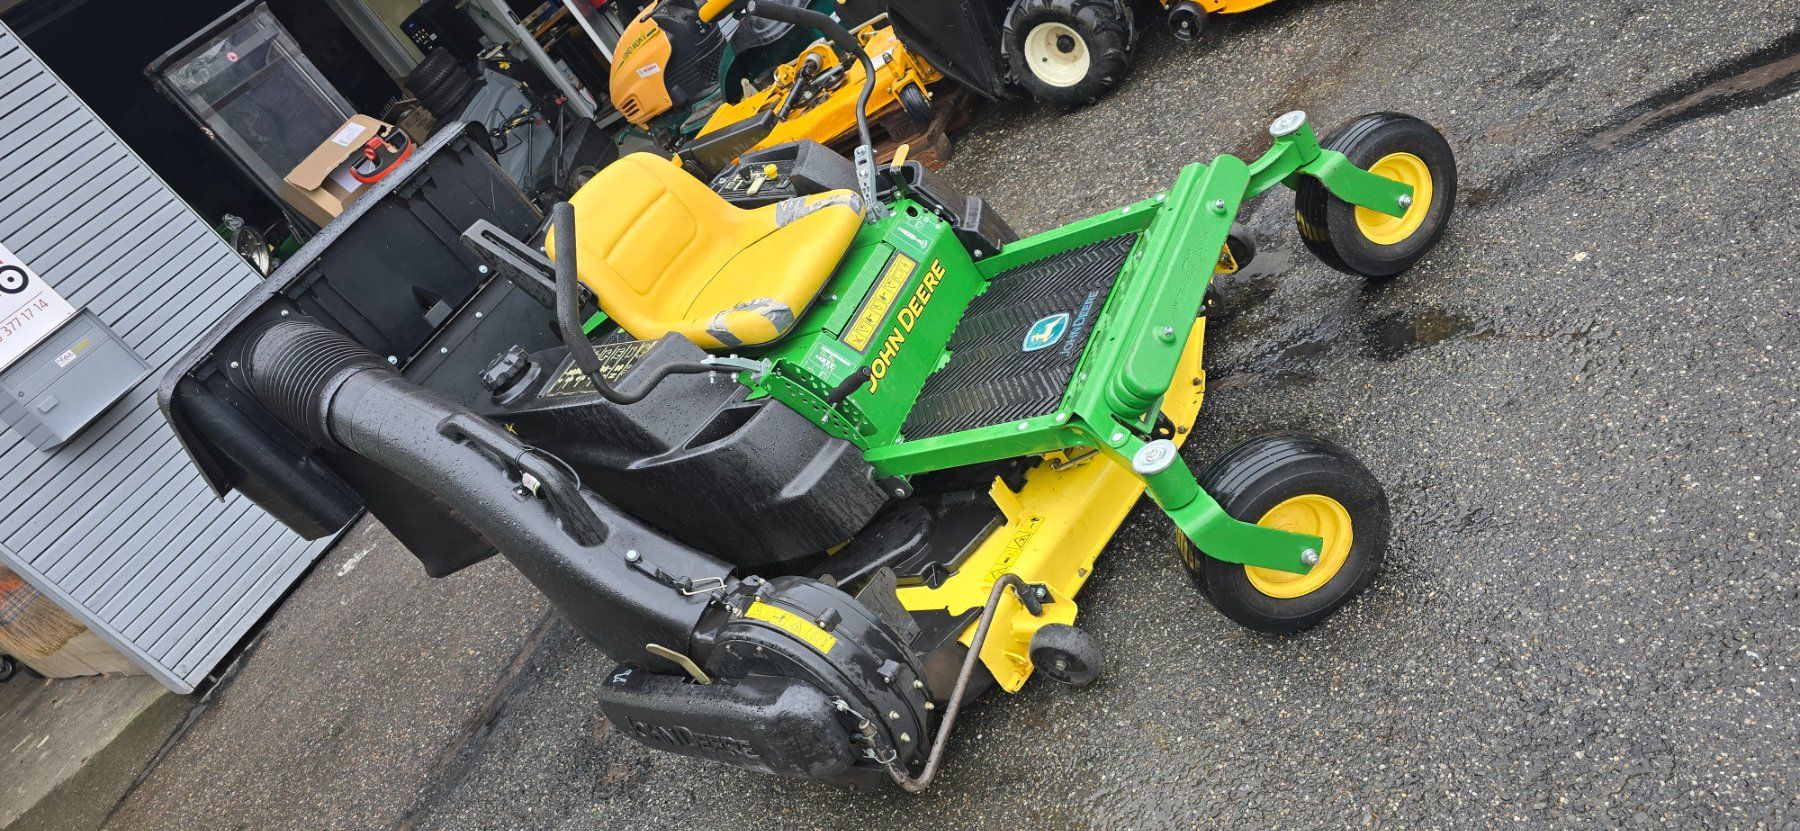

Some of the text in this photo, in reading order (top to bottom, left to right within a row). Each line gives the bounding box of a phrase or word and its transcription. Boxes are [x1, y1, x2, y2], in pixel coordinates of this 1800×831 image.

[1, 298, 49, 337] 377 17 14
[868, 256, 946, 395] JOHN DEERE
[1060, 290, 1099, 357] JOHN DEERE
